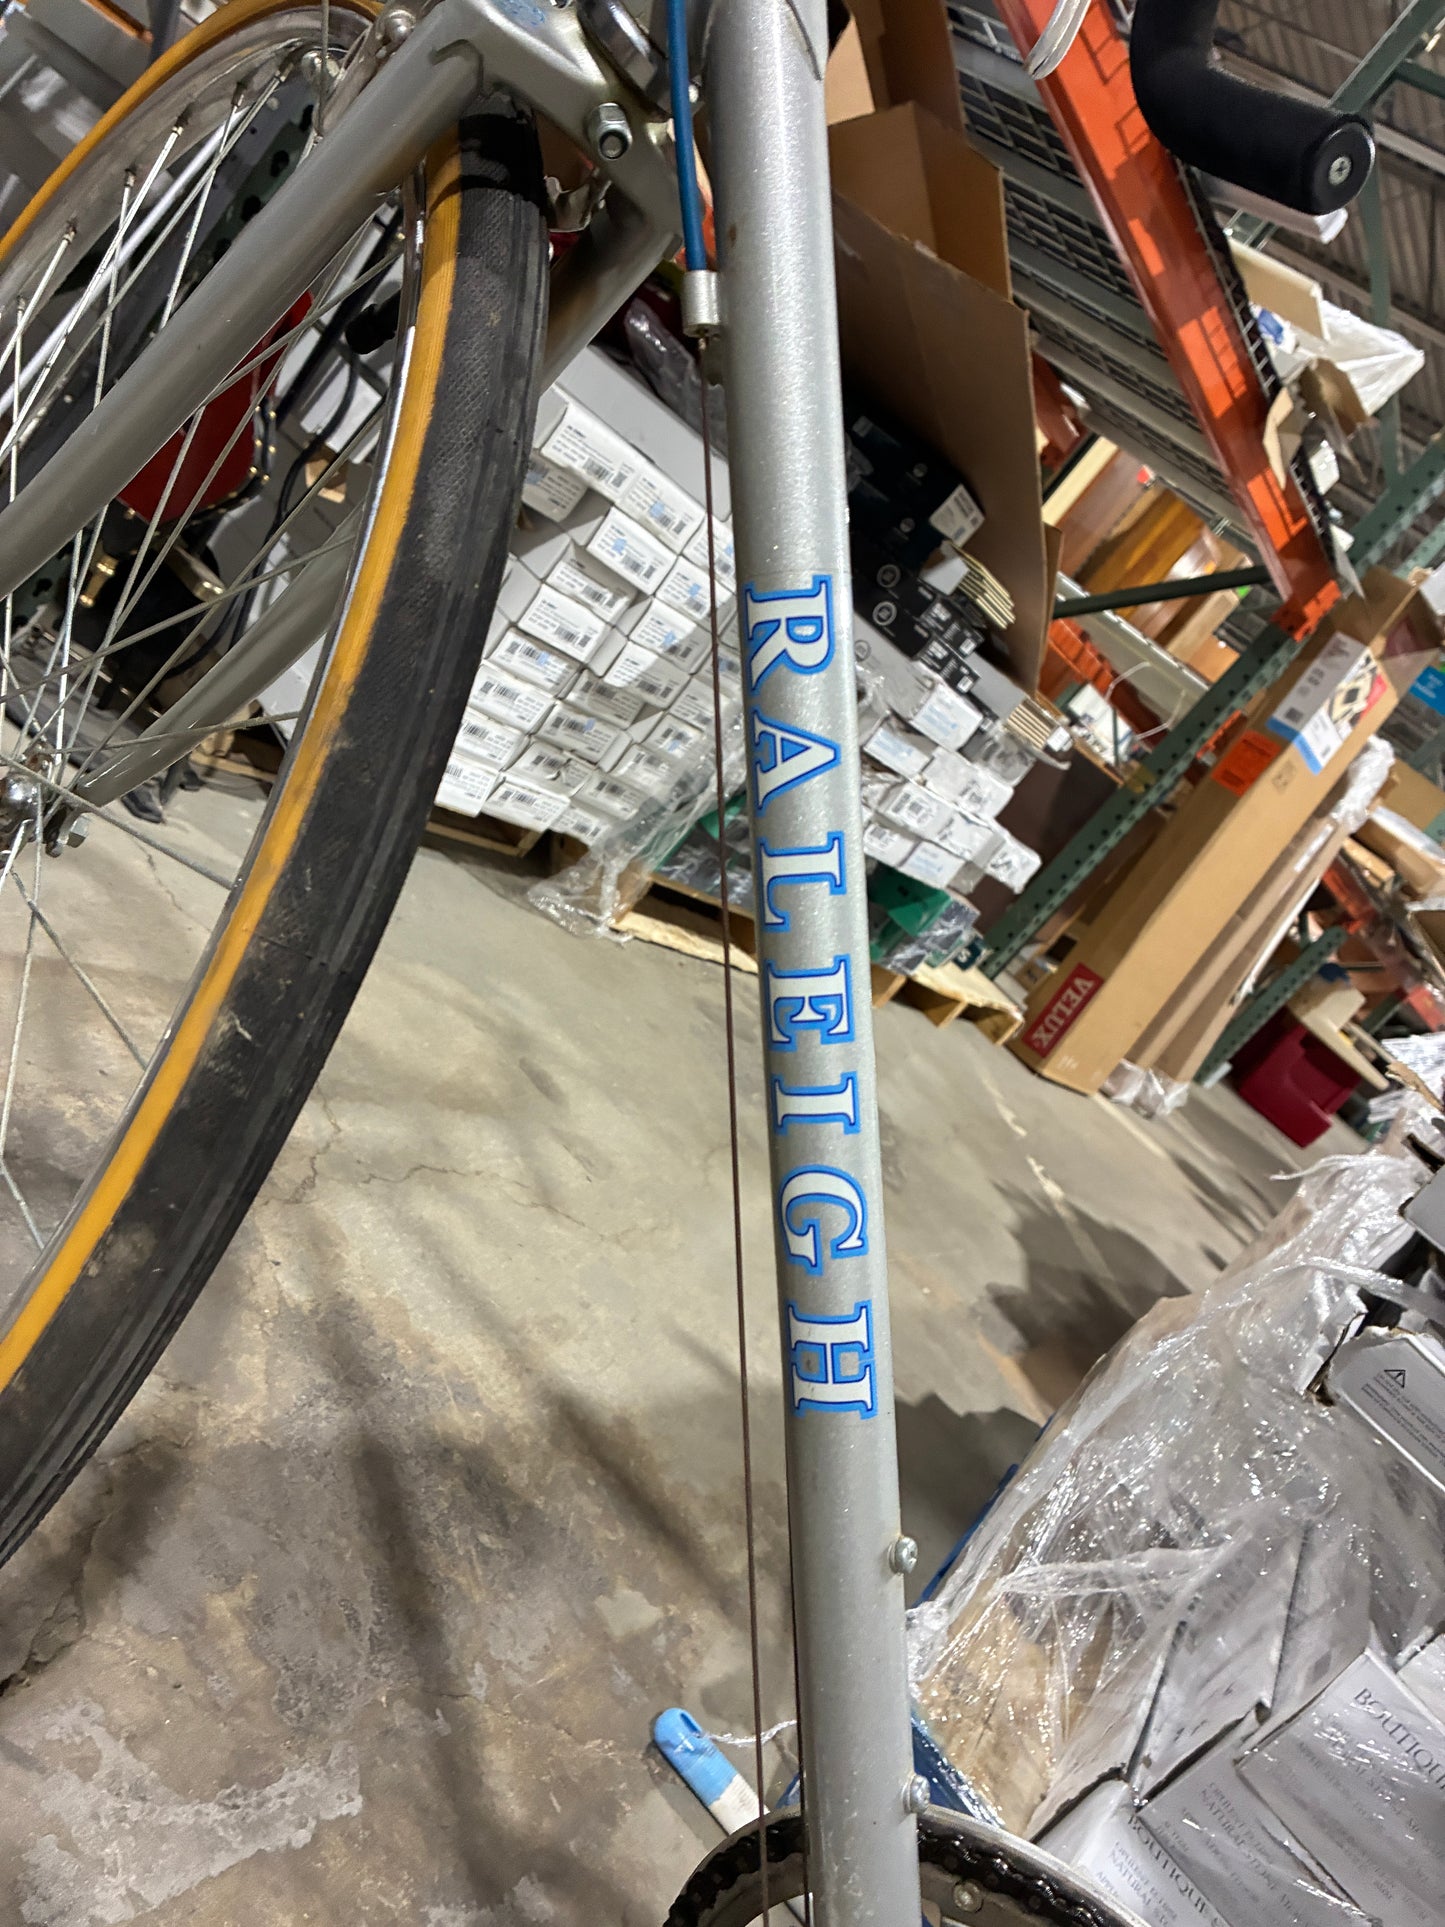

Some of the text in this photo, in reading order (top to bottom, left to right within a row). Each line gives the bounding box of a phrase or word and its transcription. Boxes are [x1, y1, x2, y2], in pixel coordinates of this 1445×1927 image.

[745, 574, 878, 1420] RALEIGH
[1033, 976, 1095, 1049] VELUX
[1353, 1687, 1445, 1790] BOUTIQU
